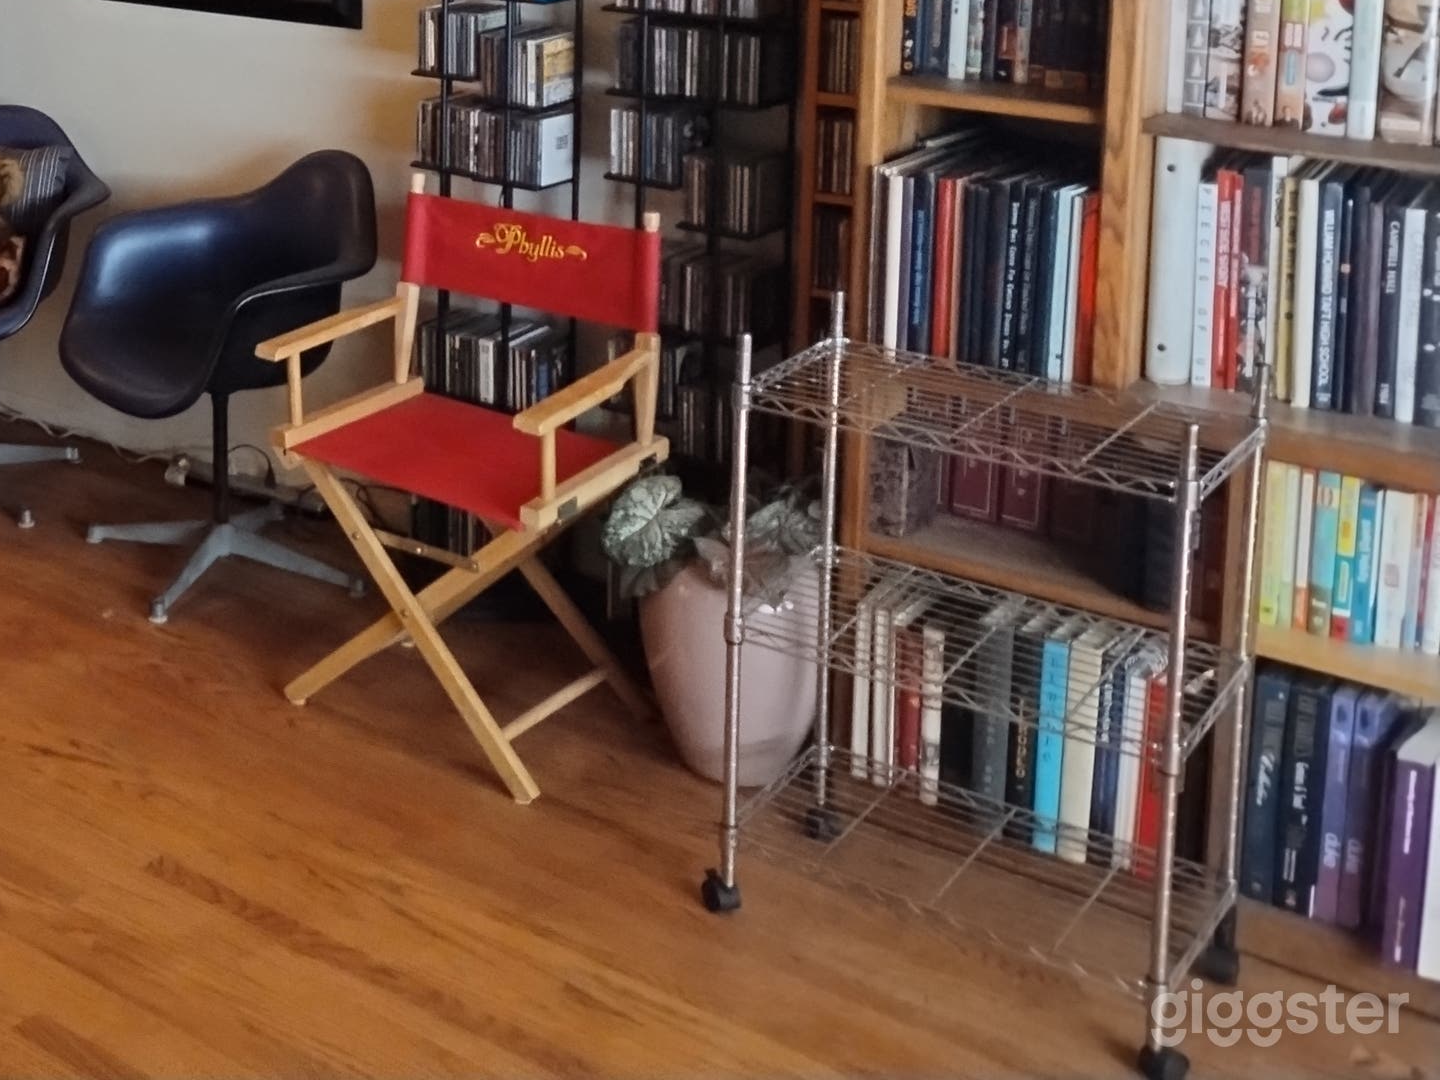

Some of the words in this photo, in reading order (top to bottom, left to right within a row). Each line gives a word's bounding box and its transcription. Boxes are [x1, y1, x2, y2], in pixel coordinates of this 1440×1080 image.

[494, 223, 565, 262] Phyllis
[1320, 296, 1333, 320] TAFT
[1319, 321, 1331, 345] HIGH
[1317, 346, 1331, 387] SCHOOL
